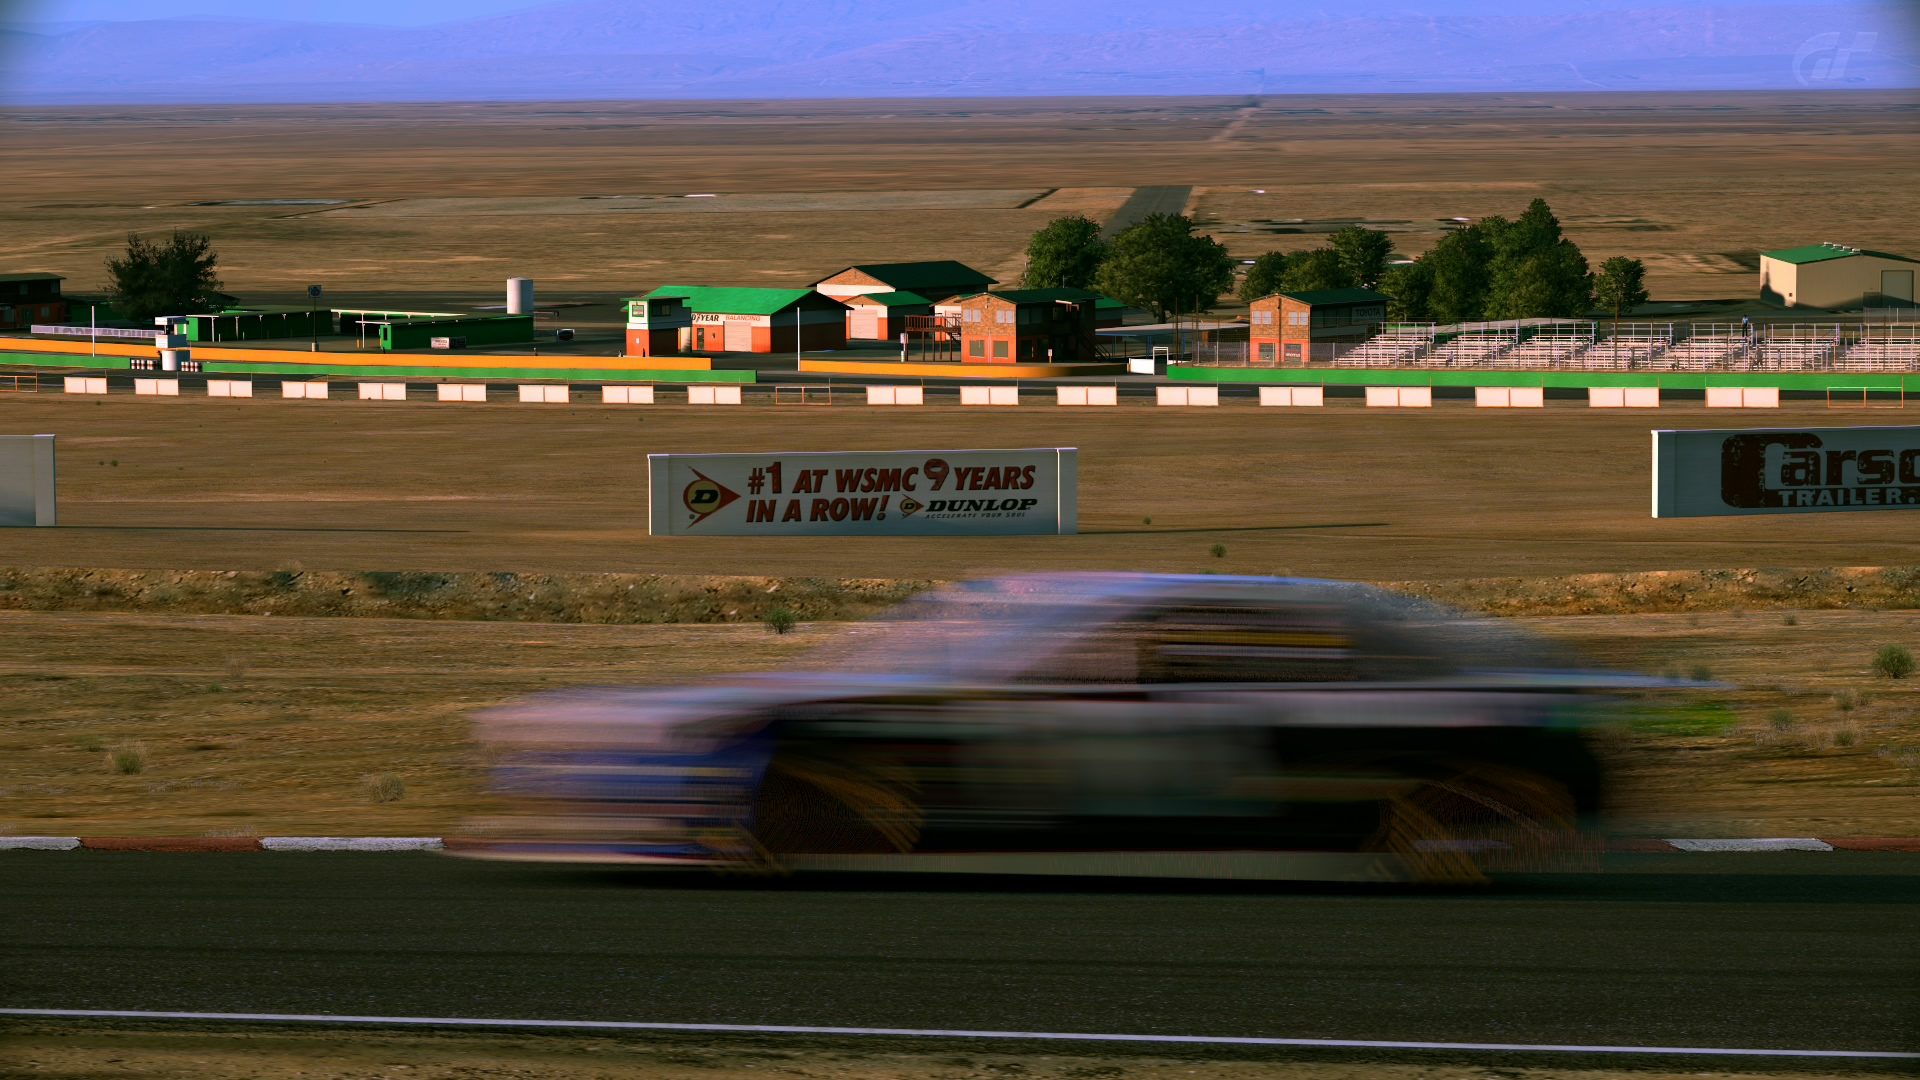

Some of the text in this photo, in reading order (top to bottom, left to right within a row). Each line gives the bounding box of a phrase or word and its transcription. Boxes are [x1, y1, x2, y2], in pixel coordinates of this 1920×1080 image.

[747, 458, 1036, 495] #1 AT WSMC 9 YEARS
[746, 495, 890, 523] IN A ROW!
[926, 498, 1038, 512] DUNLOP
